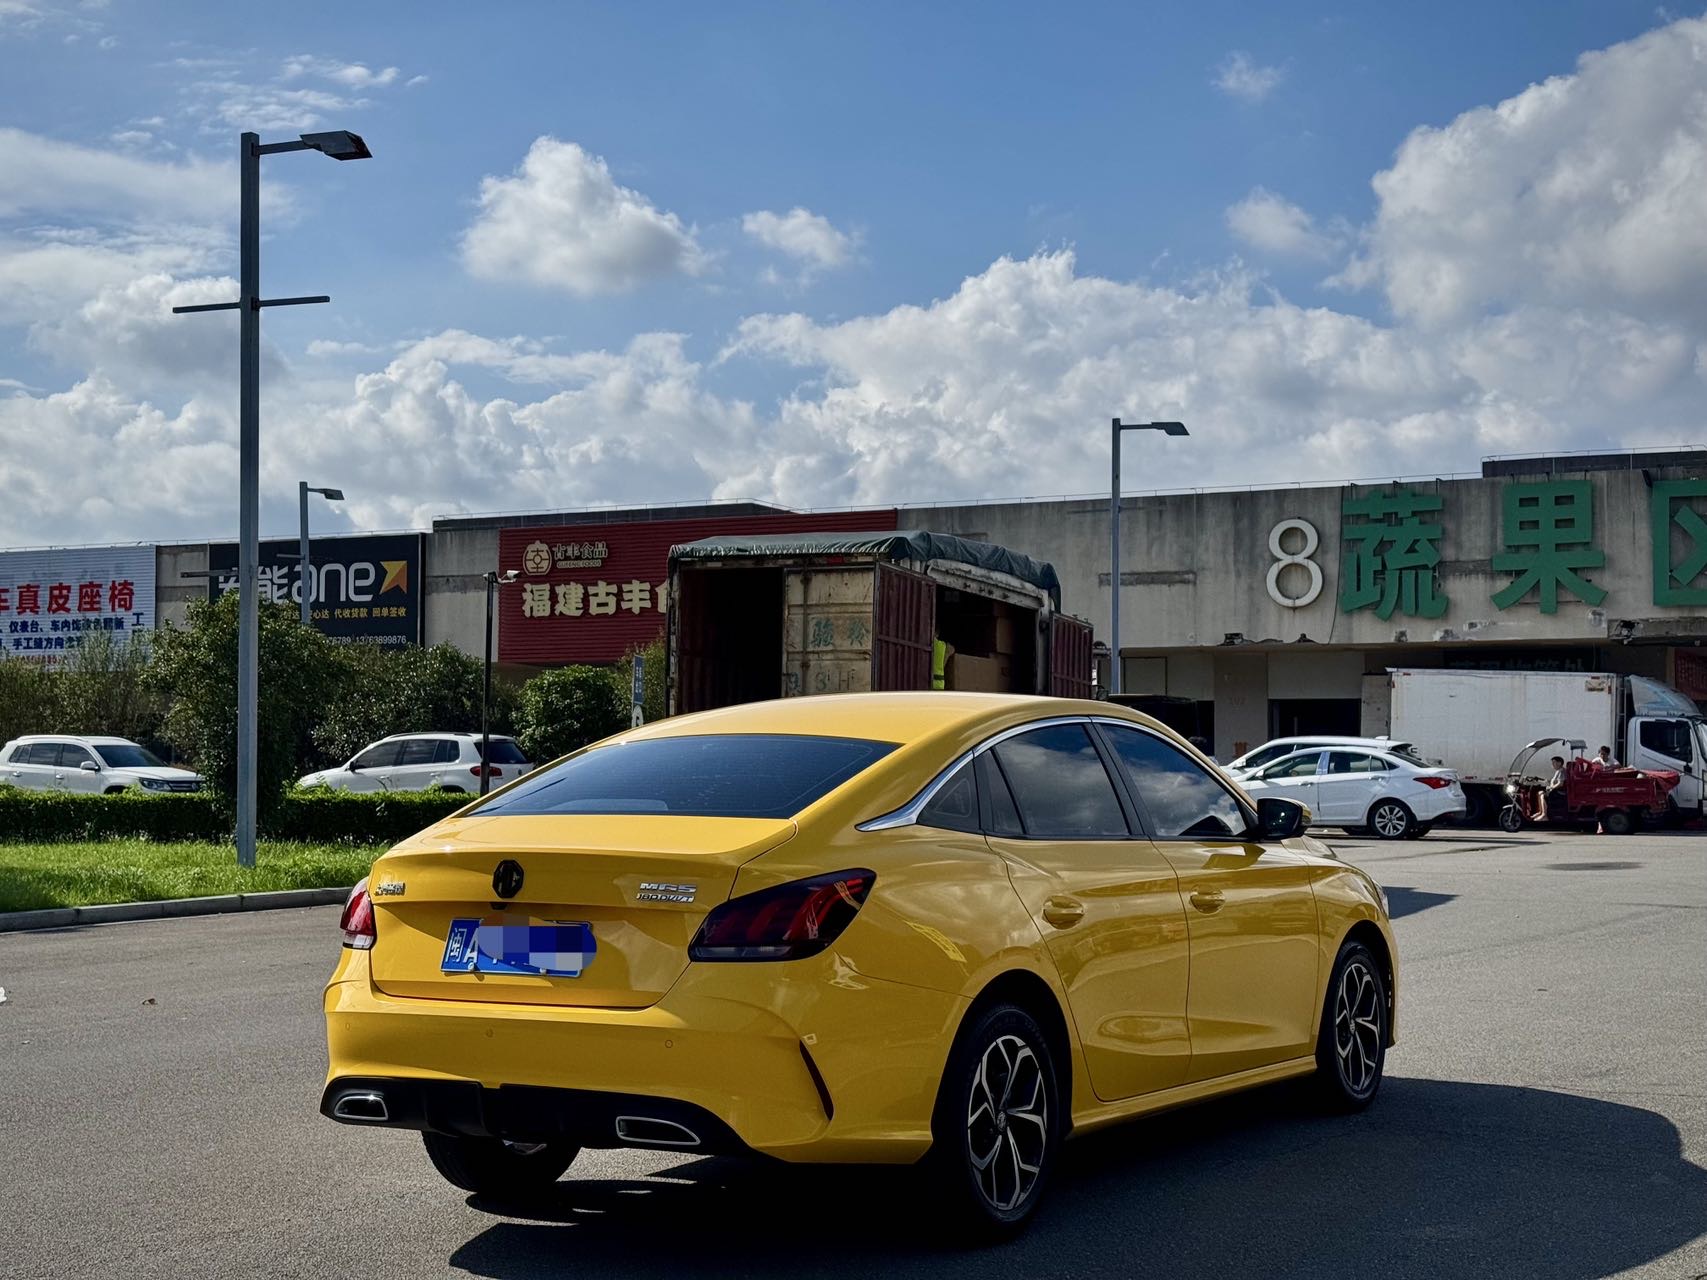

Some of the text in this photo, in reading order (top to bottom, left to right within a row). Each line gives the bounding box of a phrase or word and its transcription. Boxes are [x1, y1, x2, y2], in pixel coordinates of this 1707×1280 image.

[1265, 518, 1324, 608] 8
[334, 607, 369, 619] 代收货款
[372, 606, 407, 618] 回单签收
